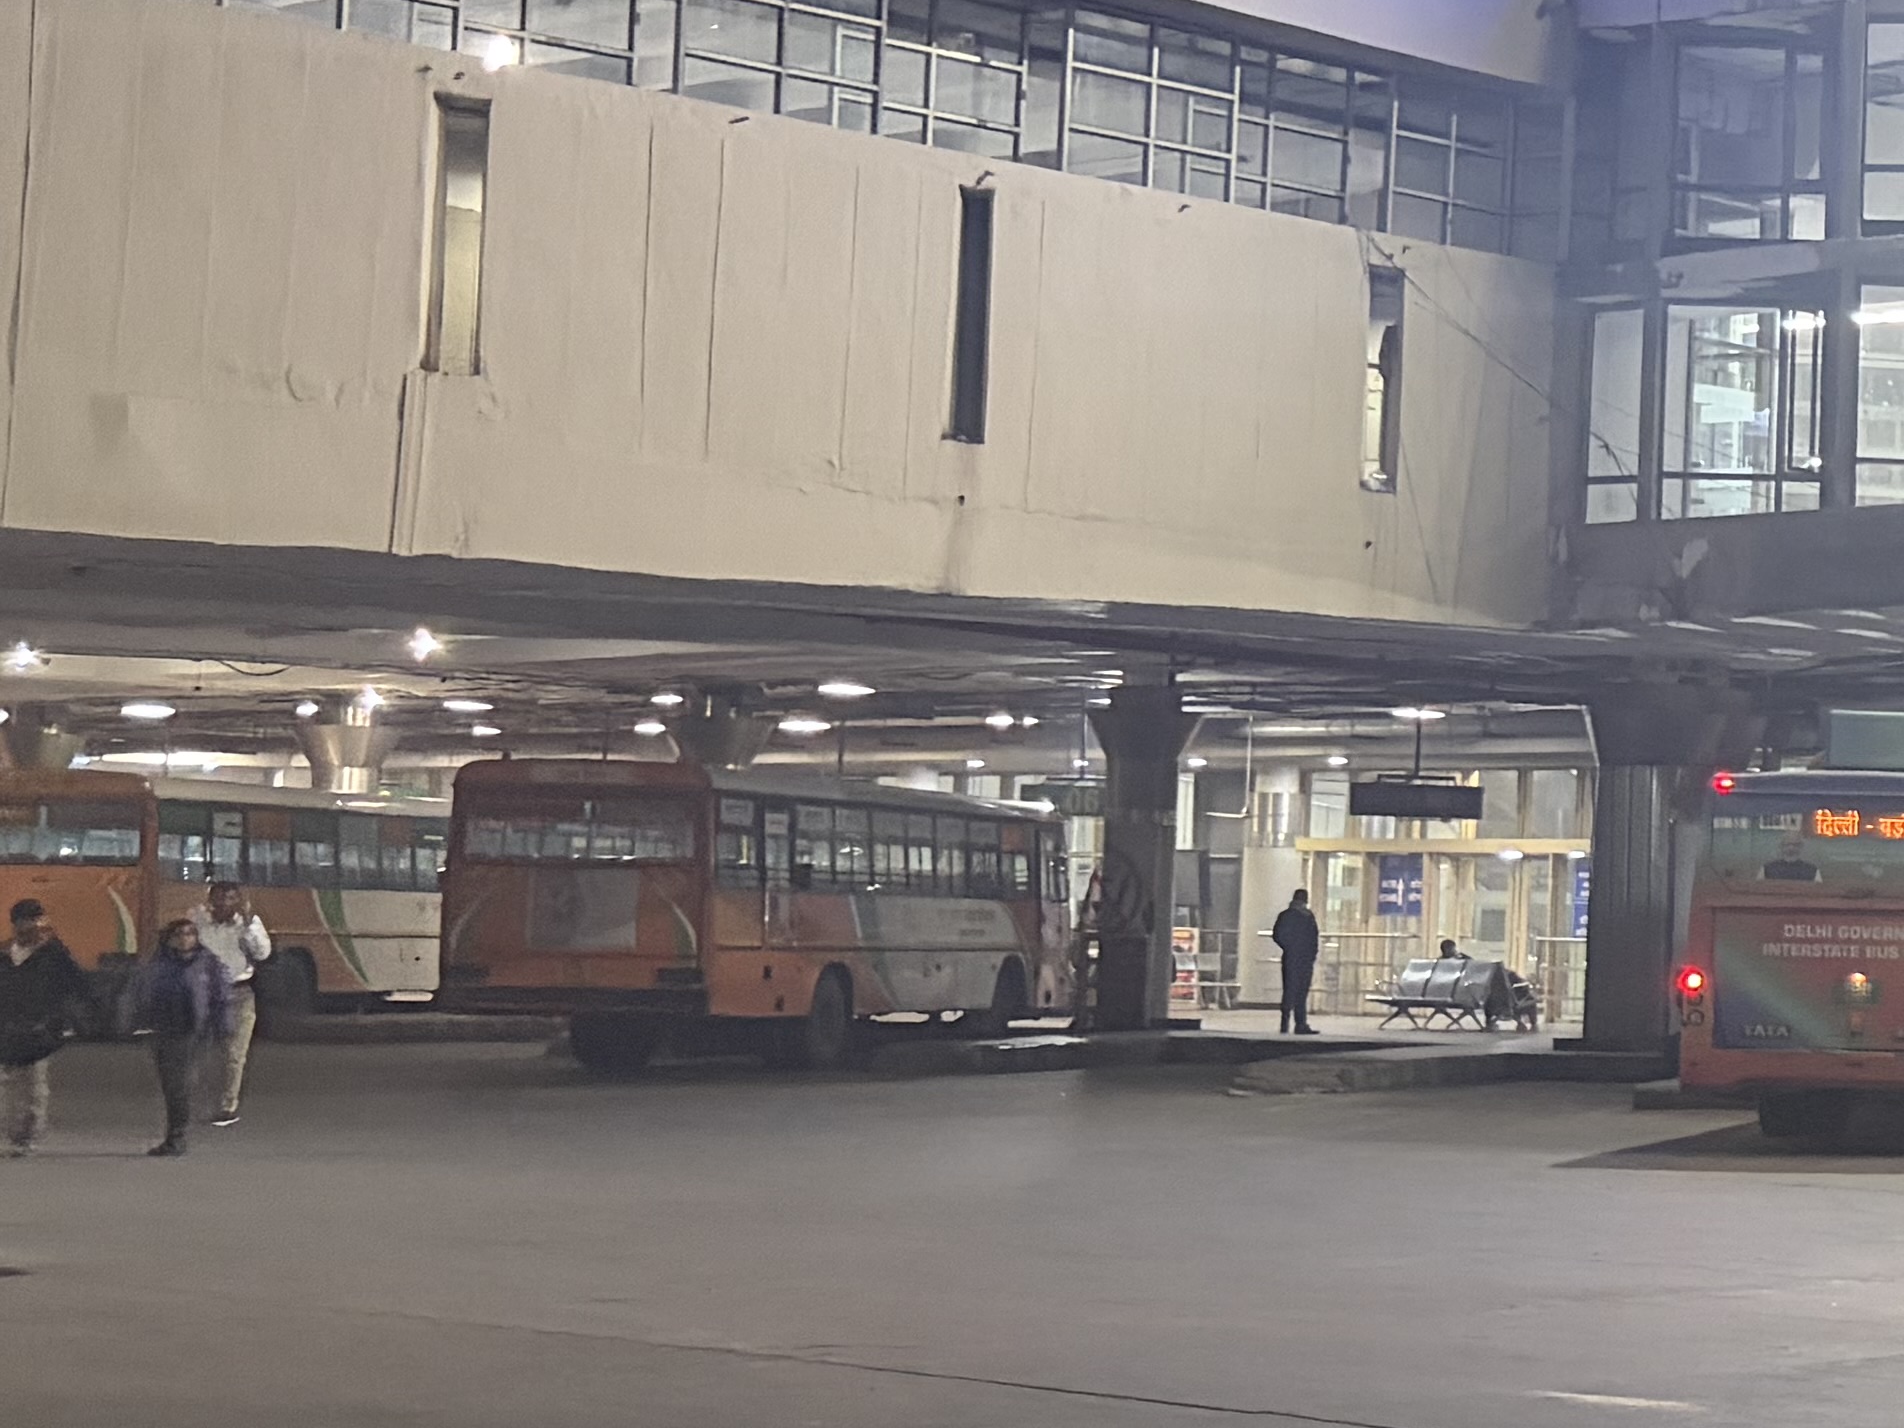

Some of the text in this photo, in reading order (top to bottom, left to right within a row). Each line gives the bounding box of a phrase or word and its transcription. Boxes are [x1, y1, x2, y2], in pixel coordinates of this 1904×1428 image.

[1783, 924, 1833, 939] DELHI
[1762, 943, 1861, 958] INTERSTATE
[1865, 945, 1900, 960] BUS
